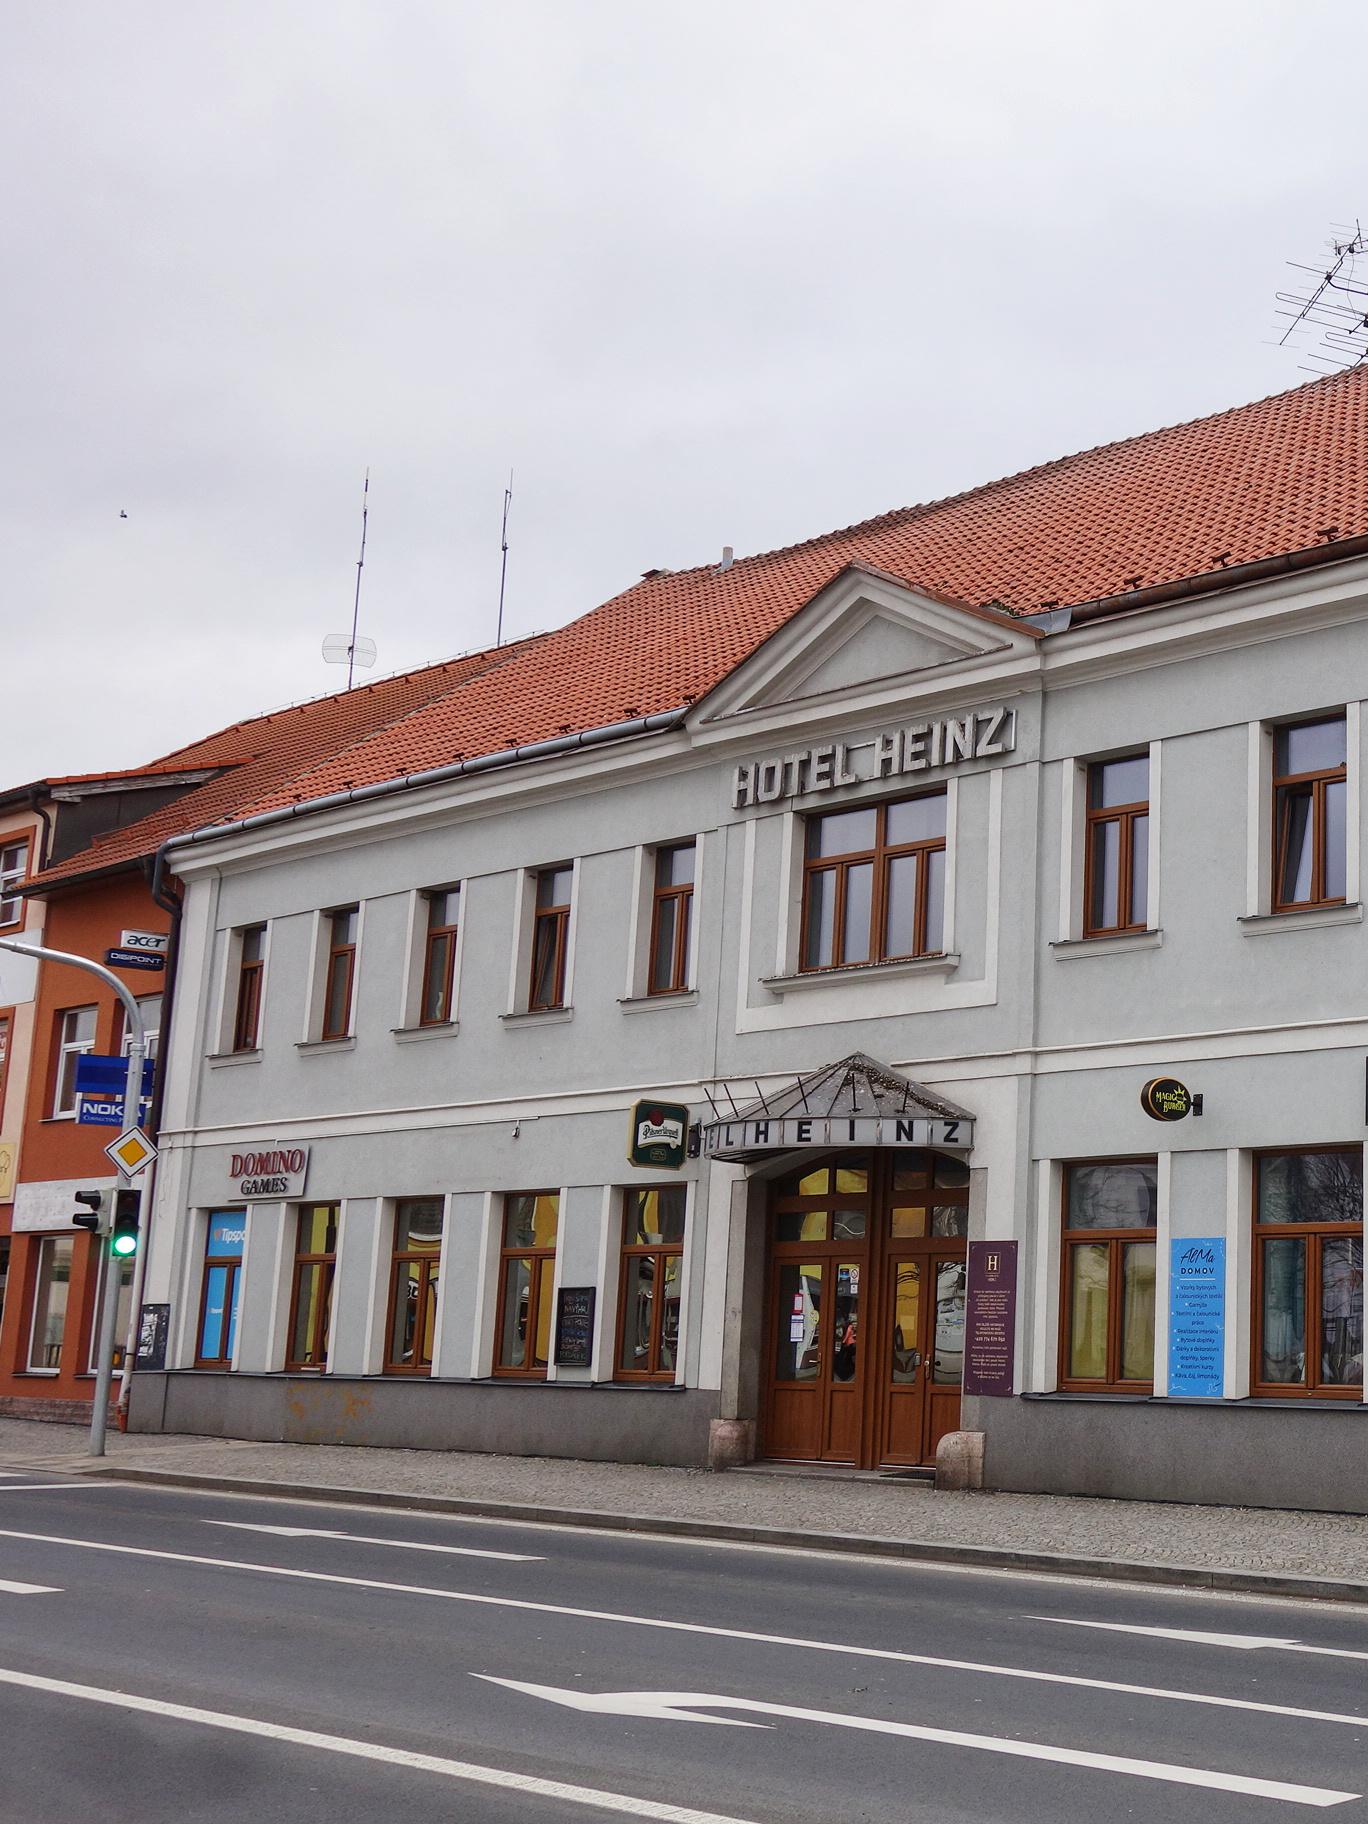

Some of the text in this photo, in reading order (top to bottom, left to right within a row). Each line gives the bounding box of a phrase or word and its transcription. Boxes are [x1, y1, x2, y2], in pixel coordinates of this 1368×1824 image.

[732, 706, 1008, 809] HOTEL HEINZ
[127, 935, 166, 948] acer
[1155, 1091, 1176, 1103] MAGIC
[83, 1102, 142, 1118] NOK
[754, 1119, 959, 1145] HEINZ
[229, 1148, 306, 1178] DOMINO
[240, 1177, 289, 1196] GAMES
[221, 1227, 246, 1244] Tipspo
[987, 1255, 998, 1271] H
[1180, 1267, 1215, 1275] DOMOV
